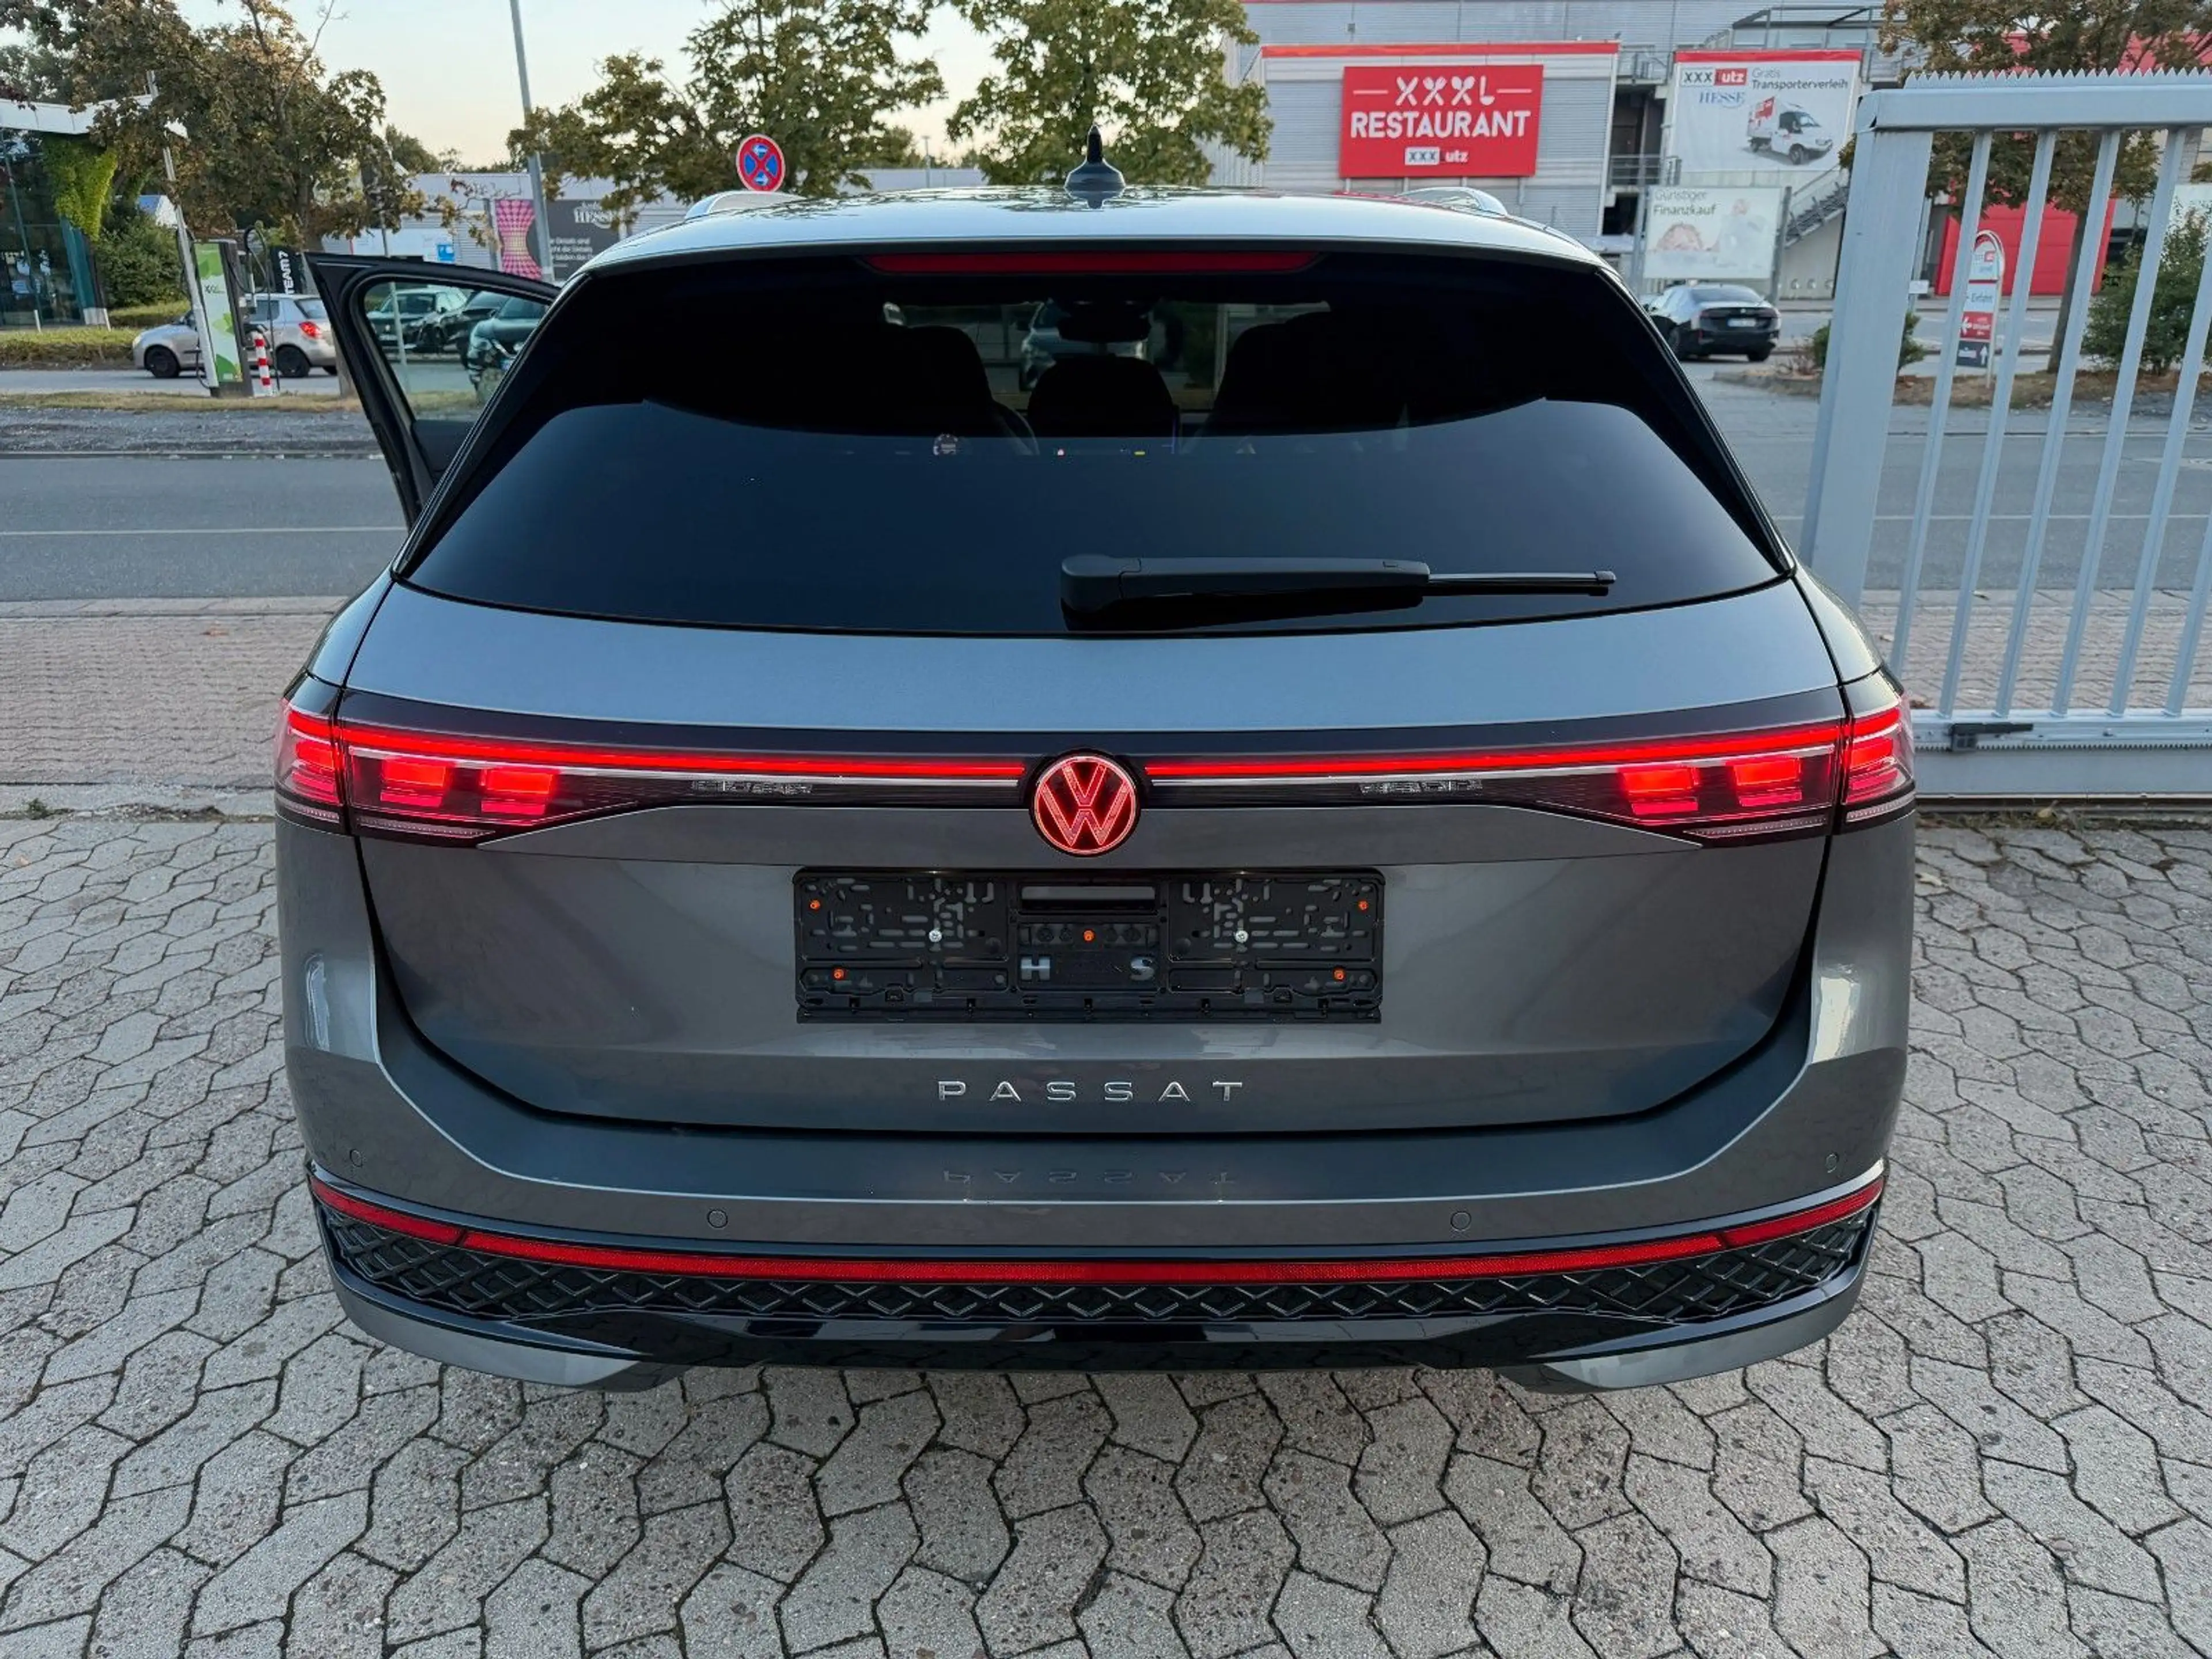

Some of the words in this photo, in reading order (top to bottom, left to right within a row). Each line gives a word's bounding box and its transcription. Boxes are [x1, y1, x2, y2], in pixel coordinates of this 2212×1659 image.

[1395, 75, 1495, 106] XXXL
[1752, 78, 1849, 91] Transporterverleih
[1699, 92, 1745, 105] HESSE
[1350, 110, 1532, 139] RESTAURANT
[938, 1080, 1243, 1102] PASSAT
